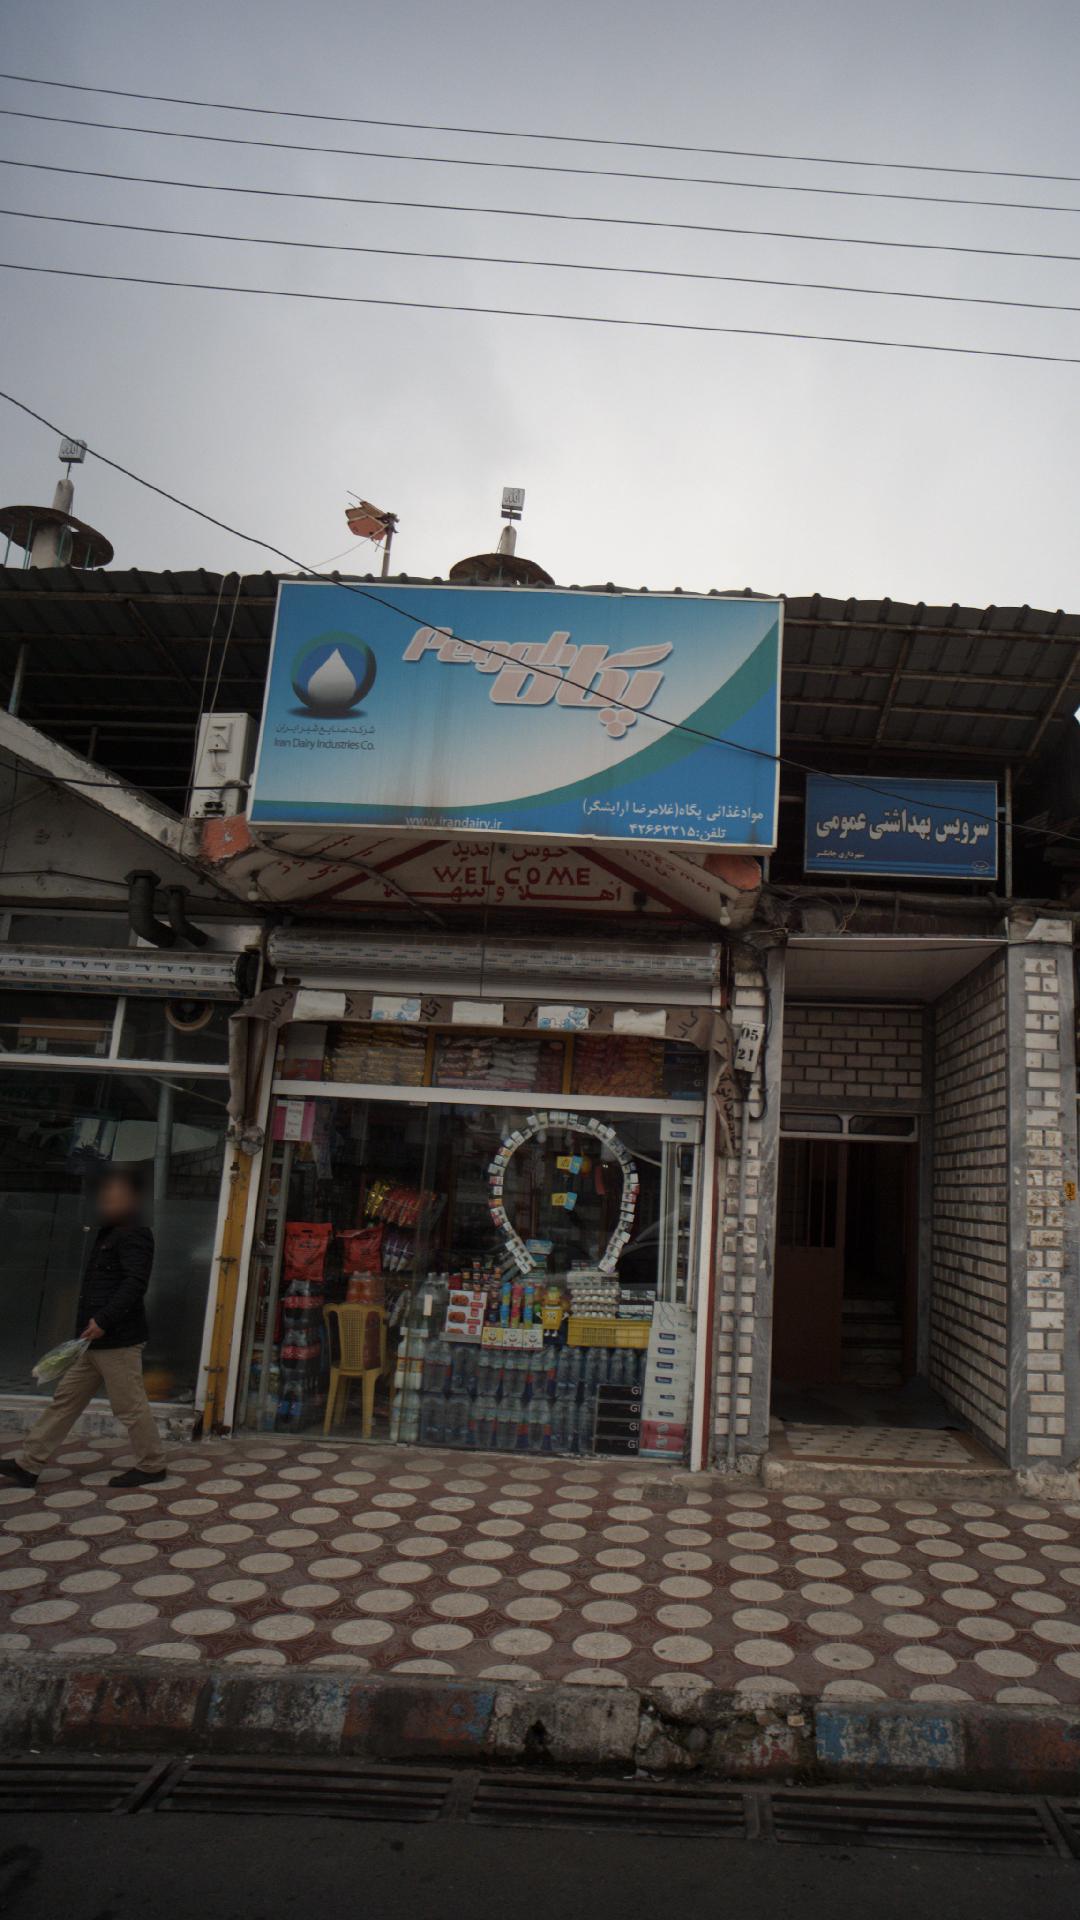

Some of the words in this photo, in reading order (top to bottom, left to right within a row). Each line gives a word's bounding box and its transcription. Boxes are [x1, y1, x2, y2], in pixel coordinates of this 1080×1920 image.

[402, 626, 578, 673] Pegah
[489, 641, 673, 738] پگاه
[275, 737, 291, 747] Iran
[292, 738, 316, 751] Dairy
[316, 739, 359, 750] Industries
[405, 815, 503, 831] www.irandairy.ir
[816, 812, 867, 839] عمومی
[869, 808, 931, 840] بهداشتی
[935, 818, 989, 844] سرویس
[433, 866, 591, 885] WELCOME
[741, 1027, 759, 1041] 05
[737, 1048, 754, 1062] 21
